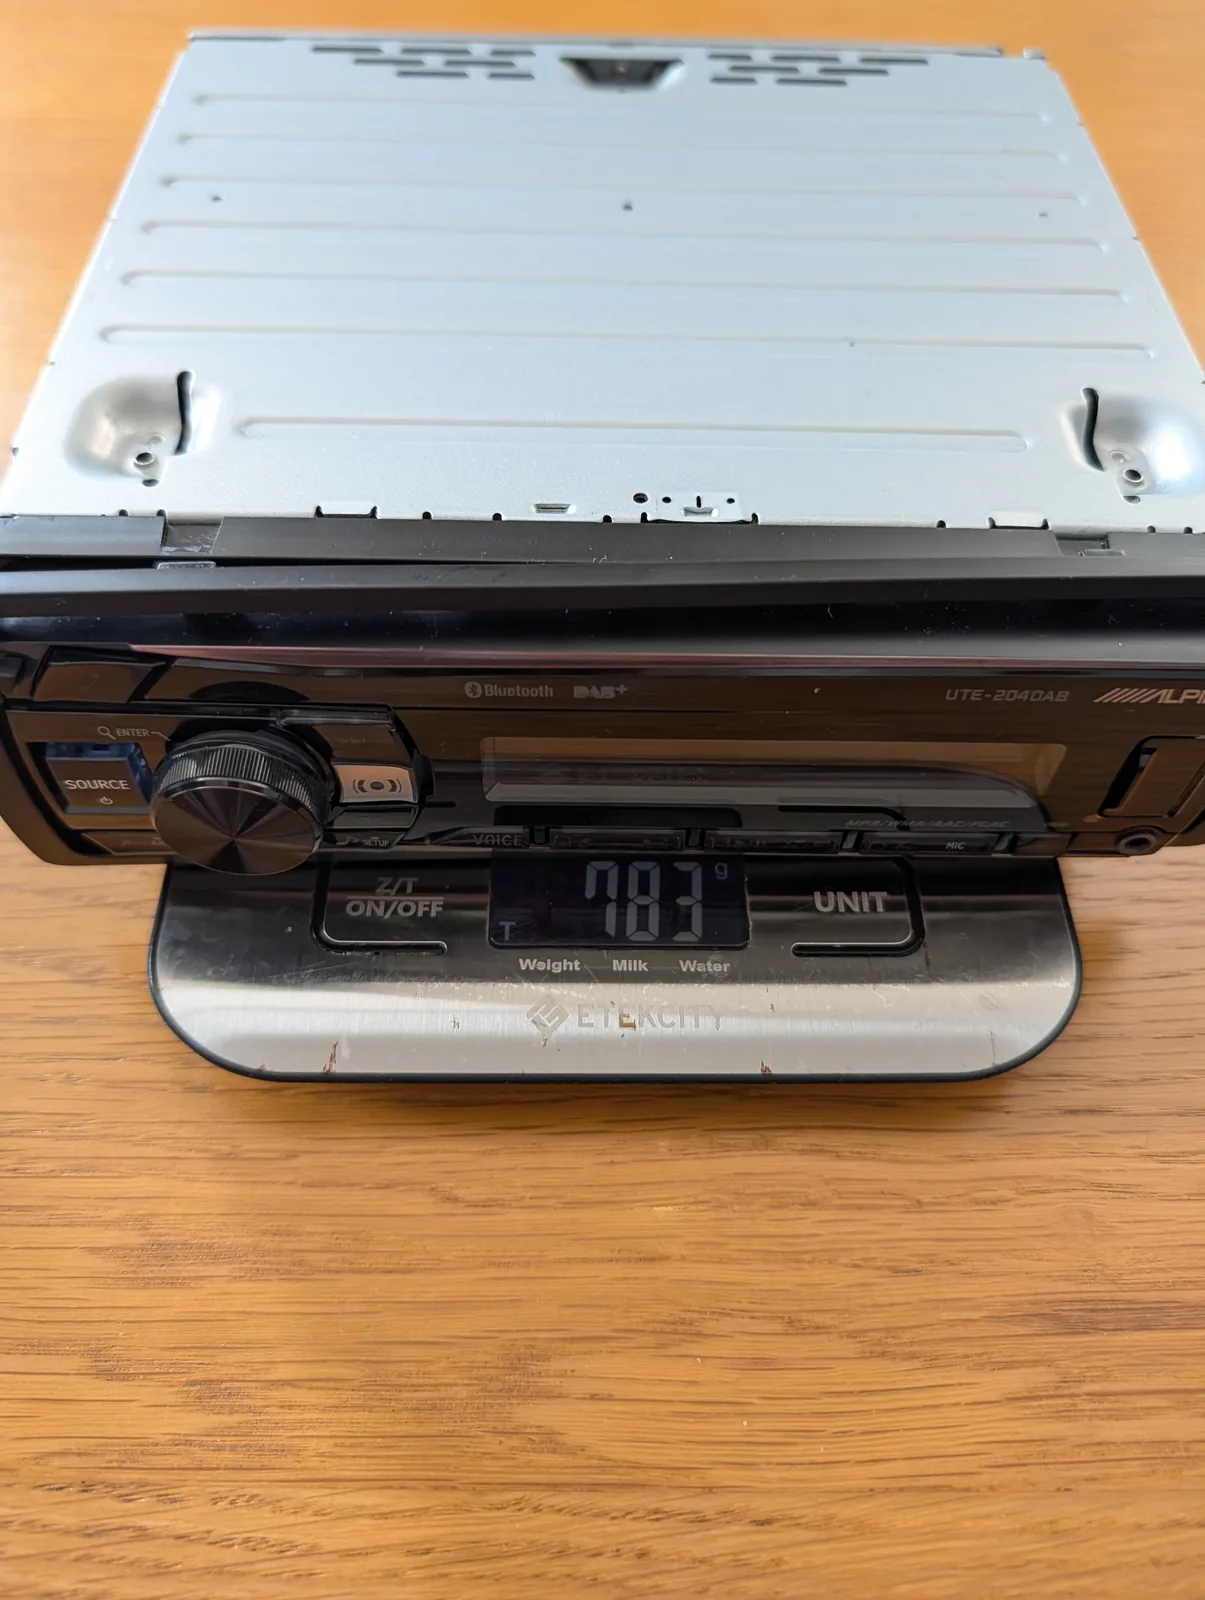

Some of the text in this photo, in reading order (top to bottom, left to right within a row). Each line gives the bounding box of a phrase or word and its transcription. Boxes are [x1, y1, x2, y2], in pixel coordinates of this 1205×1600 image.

[484, 684, 554, 698] Bluetooth
[573, 684, 628, 699] DAB+
[945, 688, 1071, 702] UTE-204DAB
[1138, 688, 1205, 704] ALPI
[115, 728, 150, 738] ENTER
[64, 779, 131, 790] SOURCE
[946, 841, 966, 850] MIC
[714, 861, 728, 880] g
[376, 877, 418, 894] Z/T
[346, 899, 444, 918] ON/OFF
[585, 861, 703, 942] 783
[814, 891, 888, 914] UNIT
[500, 921, 516, 942] T
[519, 958, 731, 973] Weight Milk Water
[577, 1003, 724, 1030] ETEKCITY
